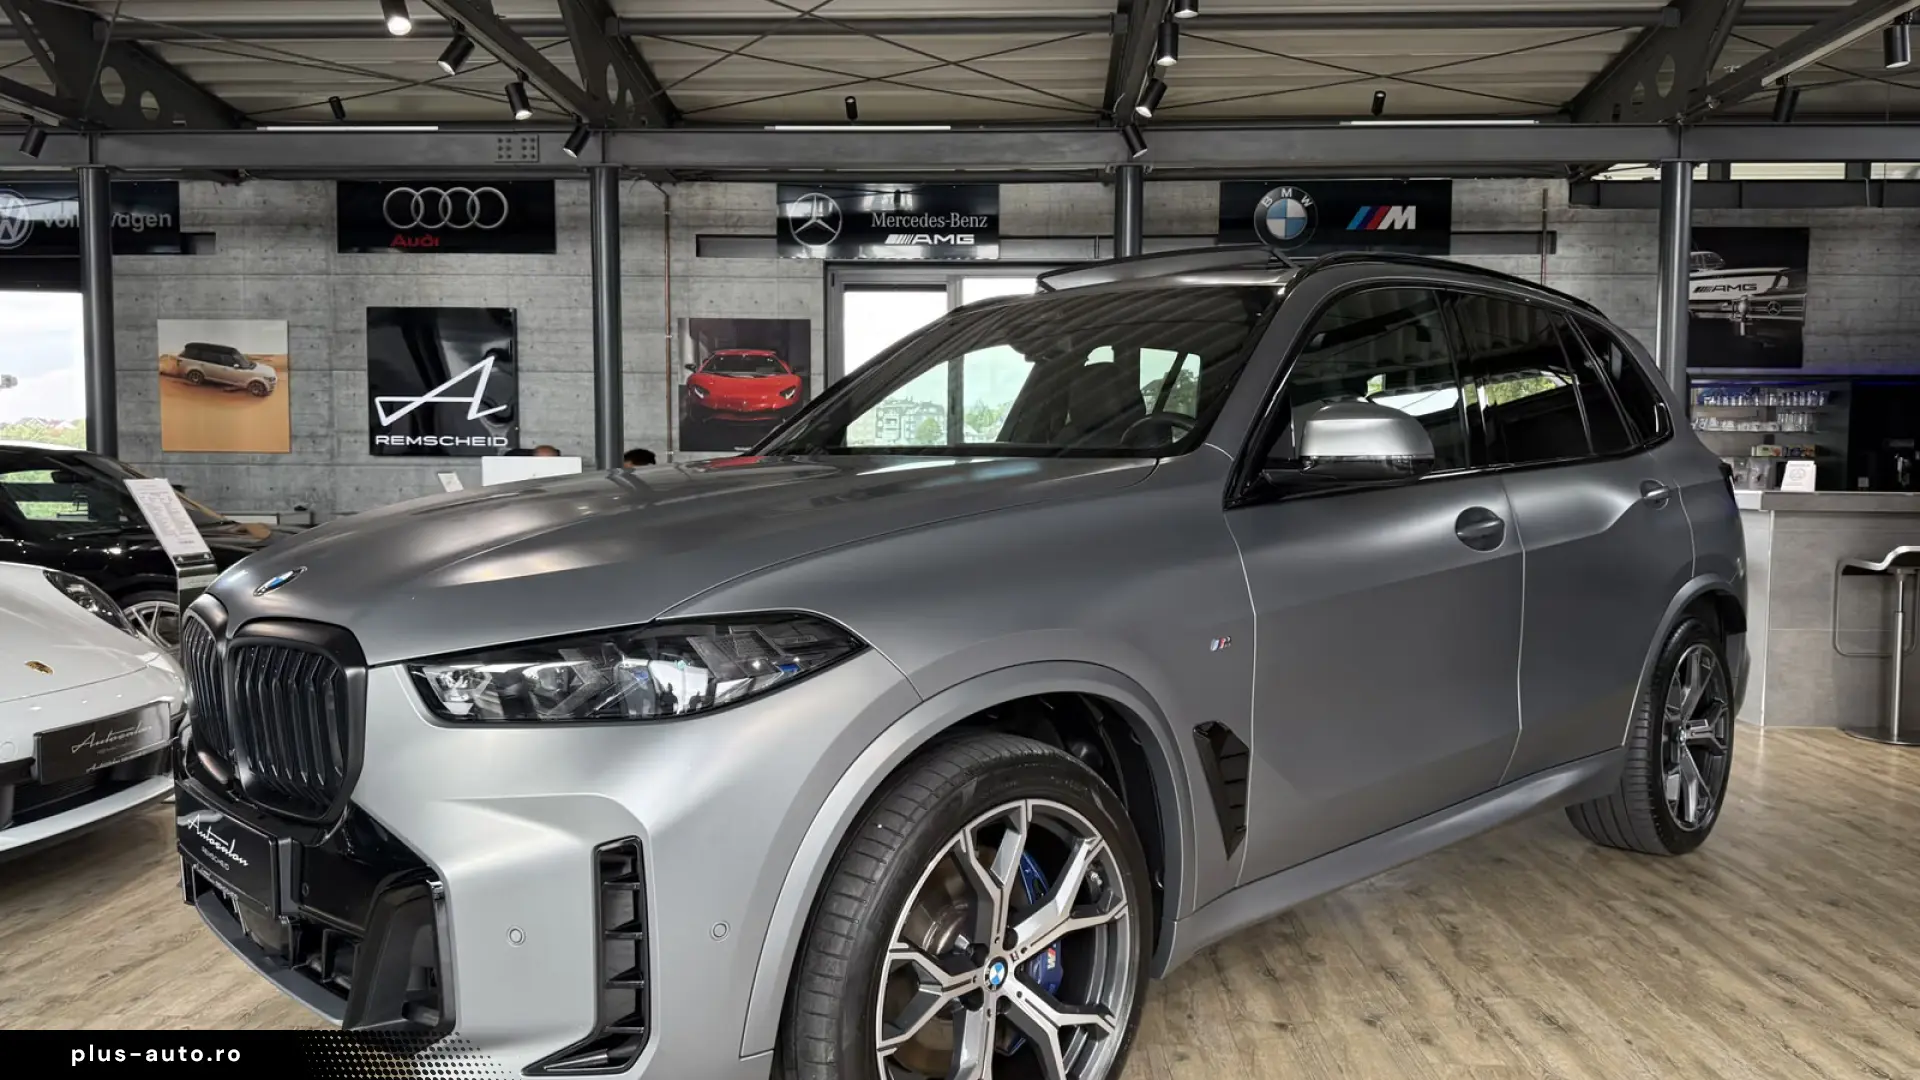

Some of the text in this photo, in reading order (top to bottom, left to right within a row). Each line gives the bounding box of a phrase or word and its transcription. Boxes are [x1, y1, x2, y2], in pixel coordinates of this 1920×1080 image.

[1261, 187, 1314, 208] BMW
[43, 209, 172, 233] Volagen
[870, 211, 989, 229] Mercedes-Benz
[390, 233, 440, 248] Audi
[911, 233, 975, 245] AMG
[1711, 283, 1758, 293] AMG
[375, 435, 509, 447] REMSCHEID
